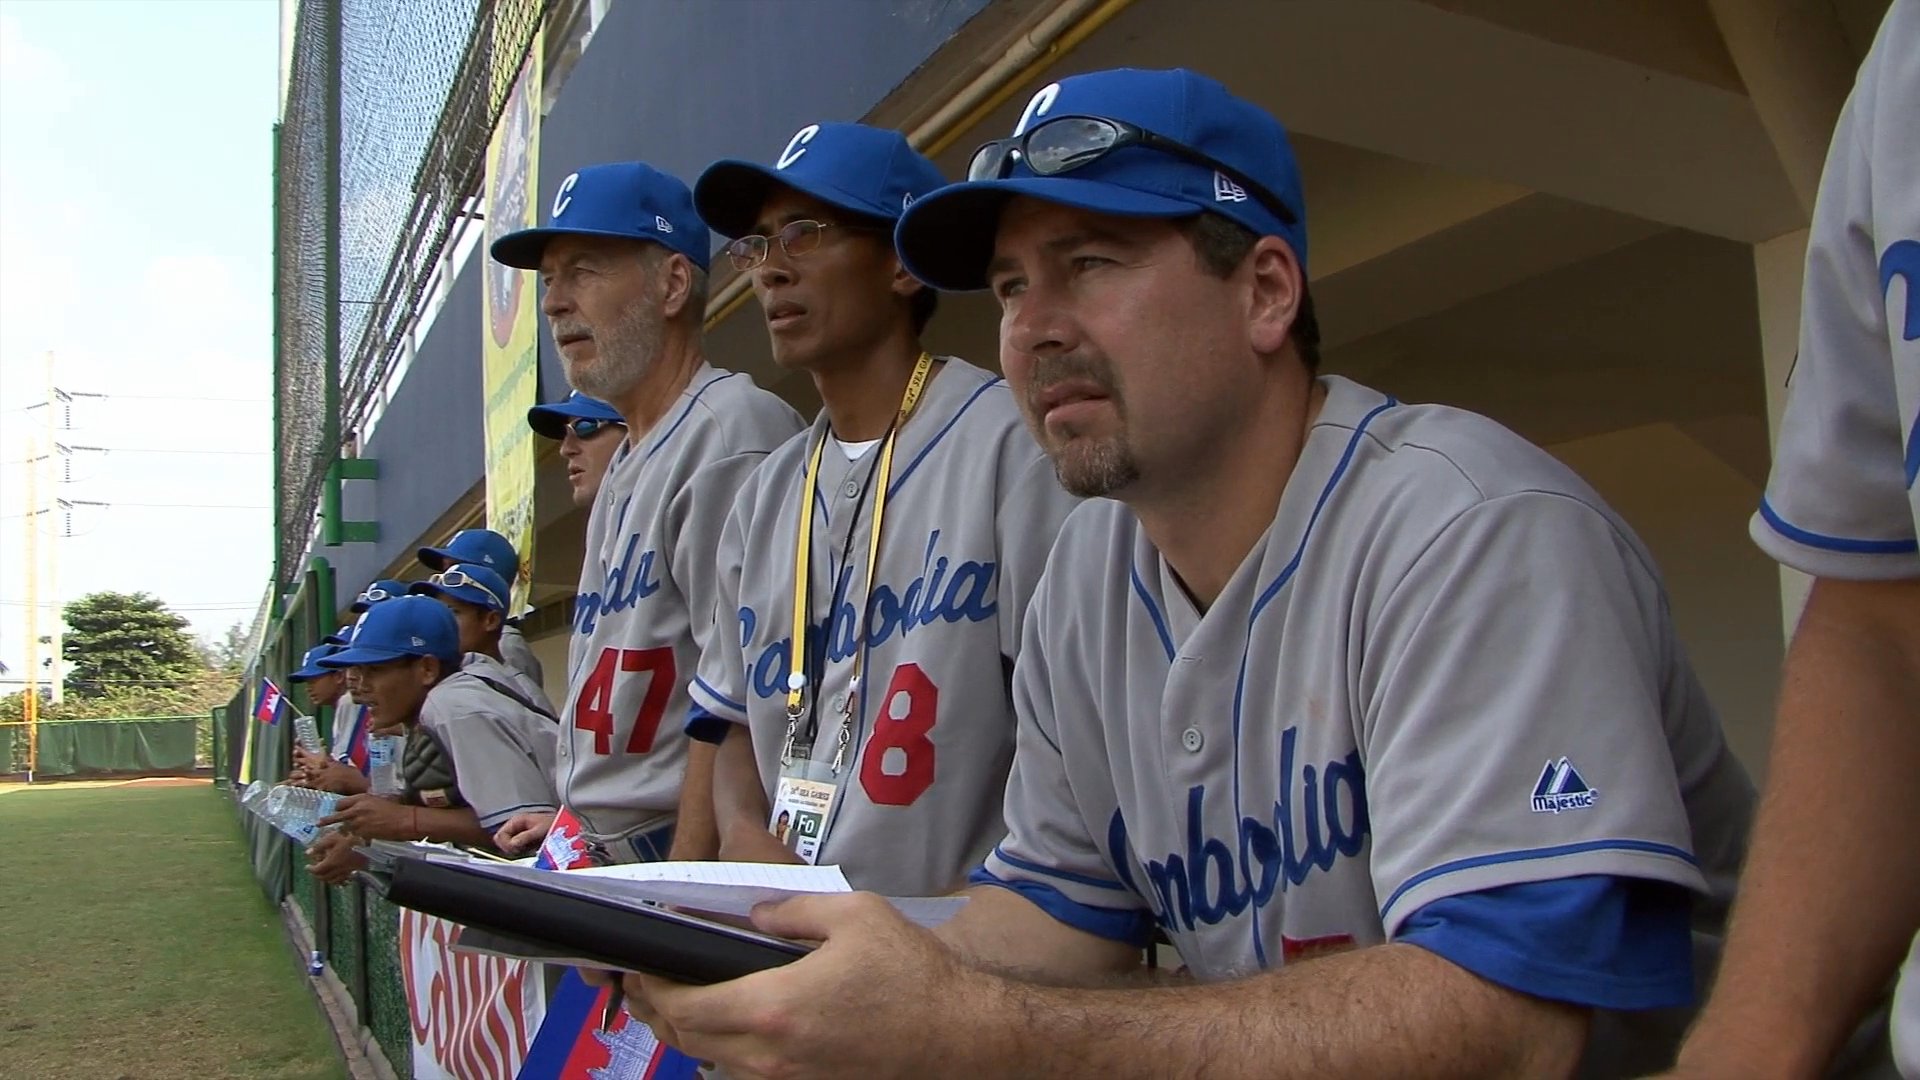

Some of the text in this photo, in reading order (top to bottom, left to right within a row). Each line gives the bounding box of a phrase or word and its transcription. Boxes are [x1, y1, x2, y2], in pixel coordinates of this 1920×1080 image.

[775, 124, 820, 171] C
[551, 172, 579, 219] C
[574, 645, 678, 757] 47
[858, 661, 940, 807] 8
[1532, 794, 1593, 813] Majestic
